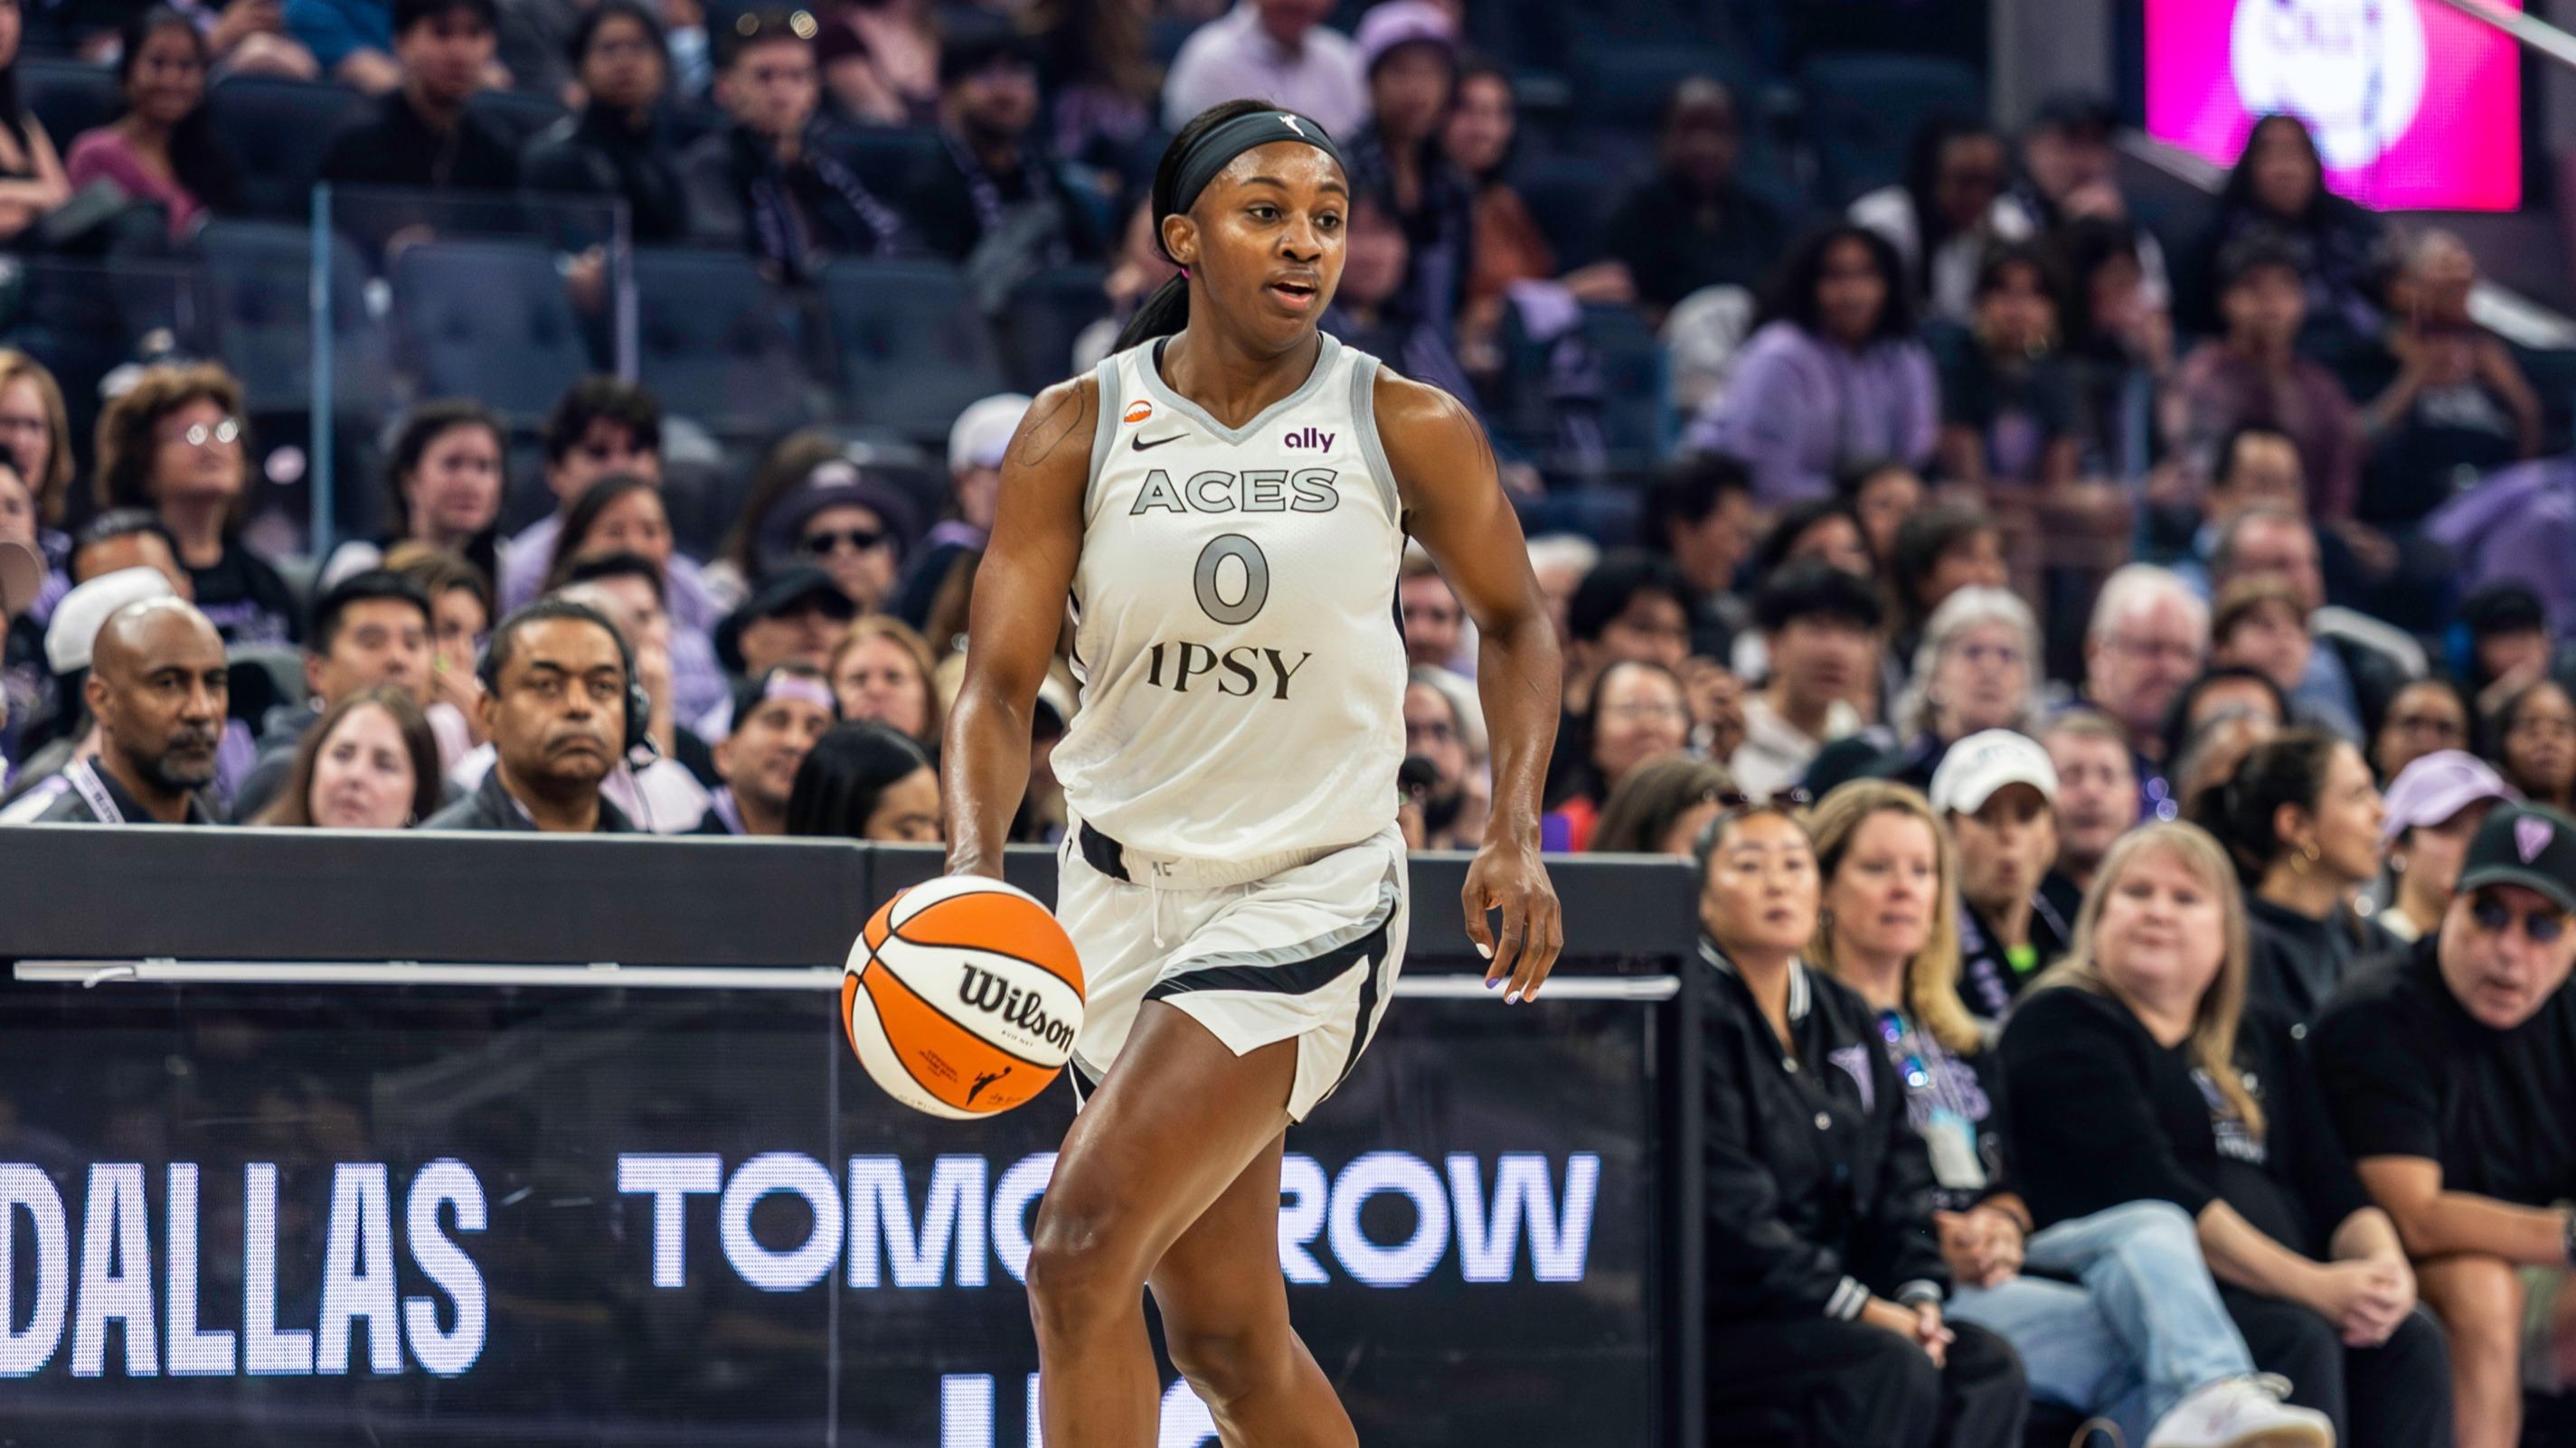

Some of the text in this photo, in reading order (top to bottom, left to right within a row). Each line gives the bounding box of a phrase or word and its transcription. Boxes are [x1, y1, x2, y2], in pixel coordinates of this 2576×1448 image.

[1284, 428, 1335, 453] ally
[1129, 467, 1340, 515] ACES
[1194, 533, 1269, 625] 0
[958, 962, 1076, 1054] Wilson
[0, 1158, 488, 1378] DALLAS
[618, 1152, 1601, 1293] TOMROW
